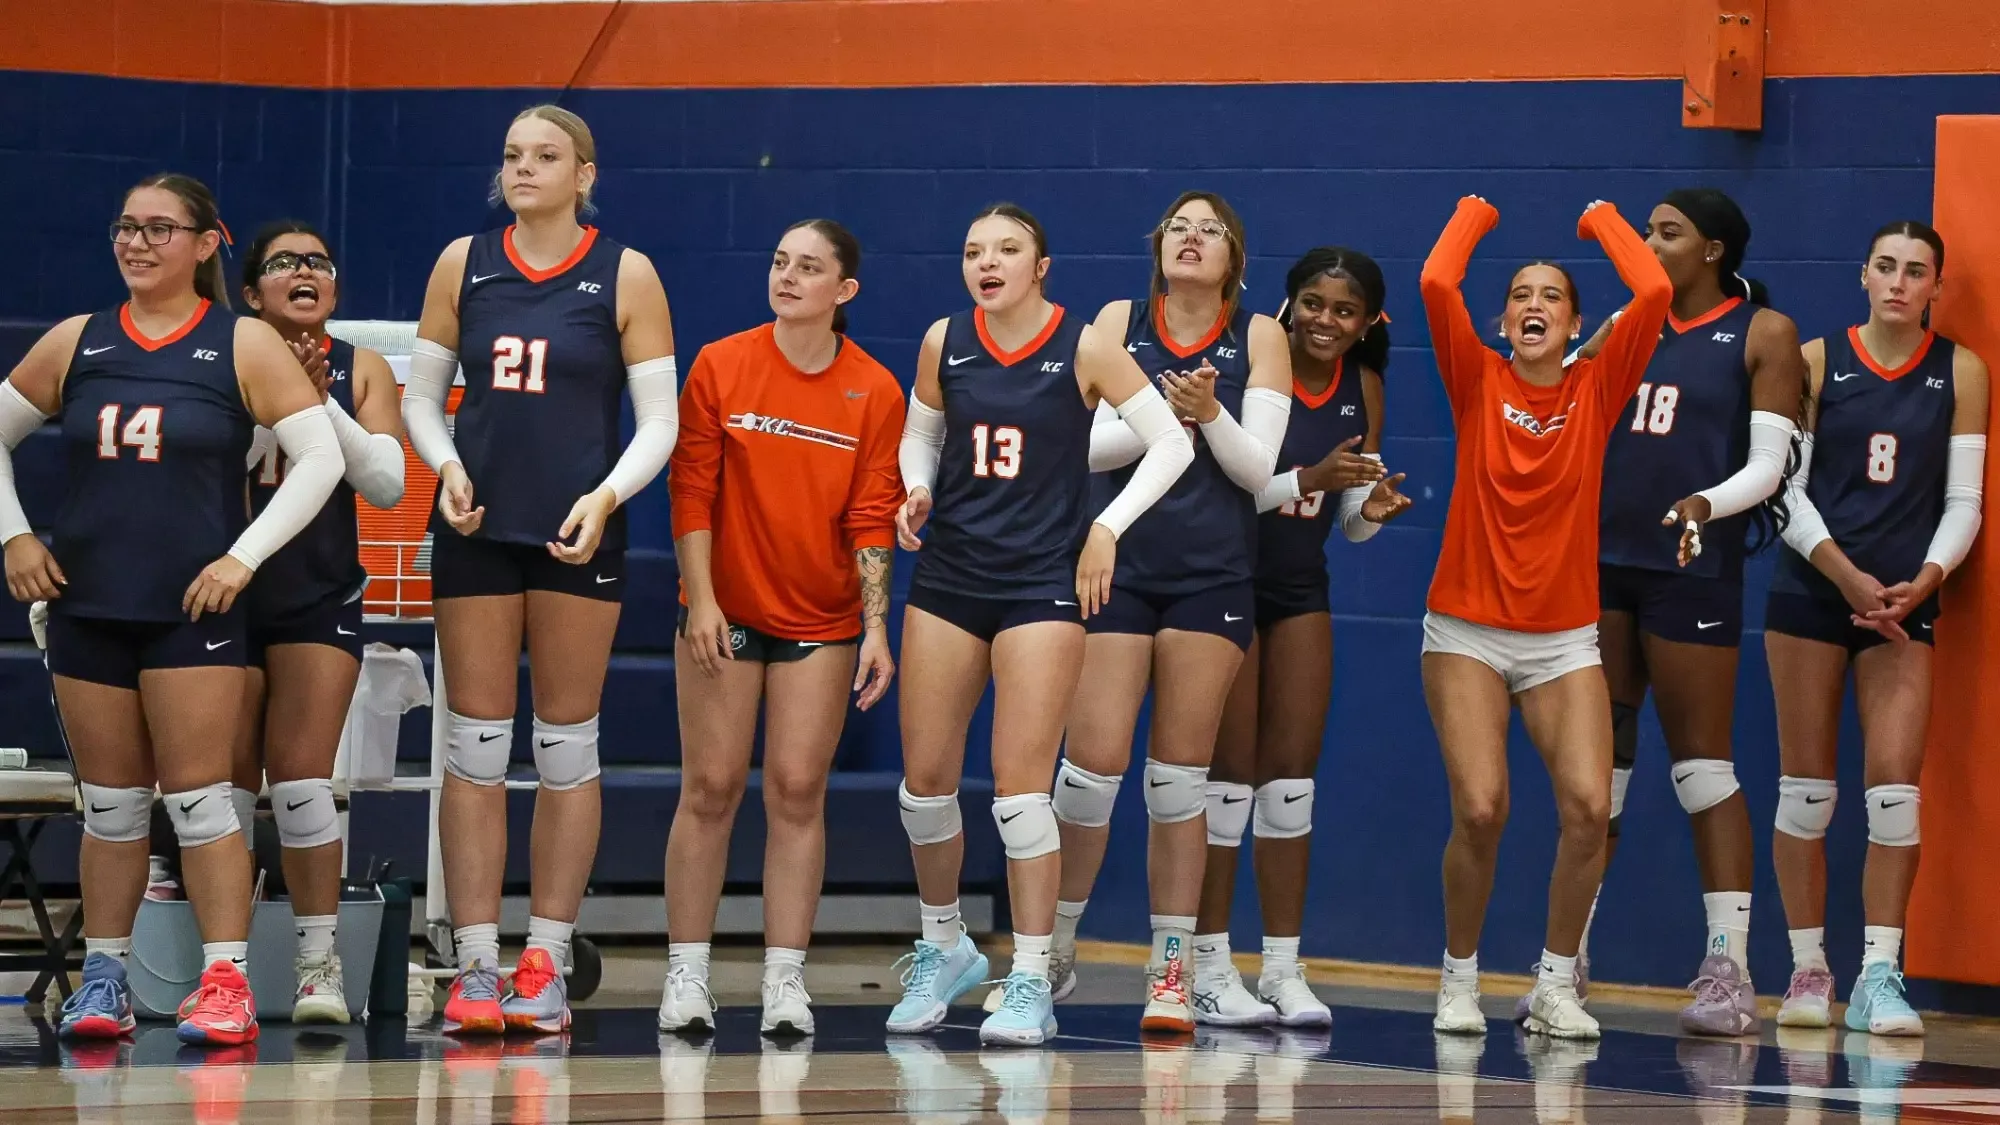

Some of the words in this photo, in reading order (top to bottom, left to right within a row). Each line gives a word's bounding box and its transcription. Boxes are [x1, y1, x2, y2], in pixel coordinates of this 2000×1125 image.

[577, 281, 602, 294] KC
[1711, 332, 1736, 343] KC
[192, 348, 219, 361] KC
[1216, 346, 1237, 359] KC
[492, 336, 548, 393] 21
[1040, 361, 1064, 373] KC
[1925, 376, 1944, 389] KC
[1340, 405, 1356, 416] KC
[1631, 382, 1680, 434] 18
[758, 415, 794, 436] KC
[97, 403, 164, 462] 14
[971, 423, 1024, 479] 13
[1867, 432, 1897, 483] 8
